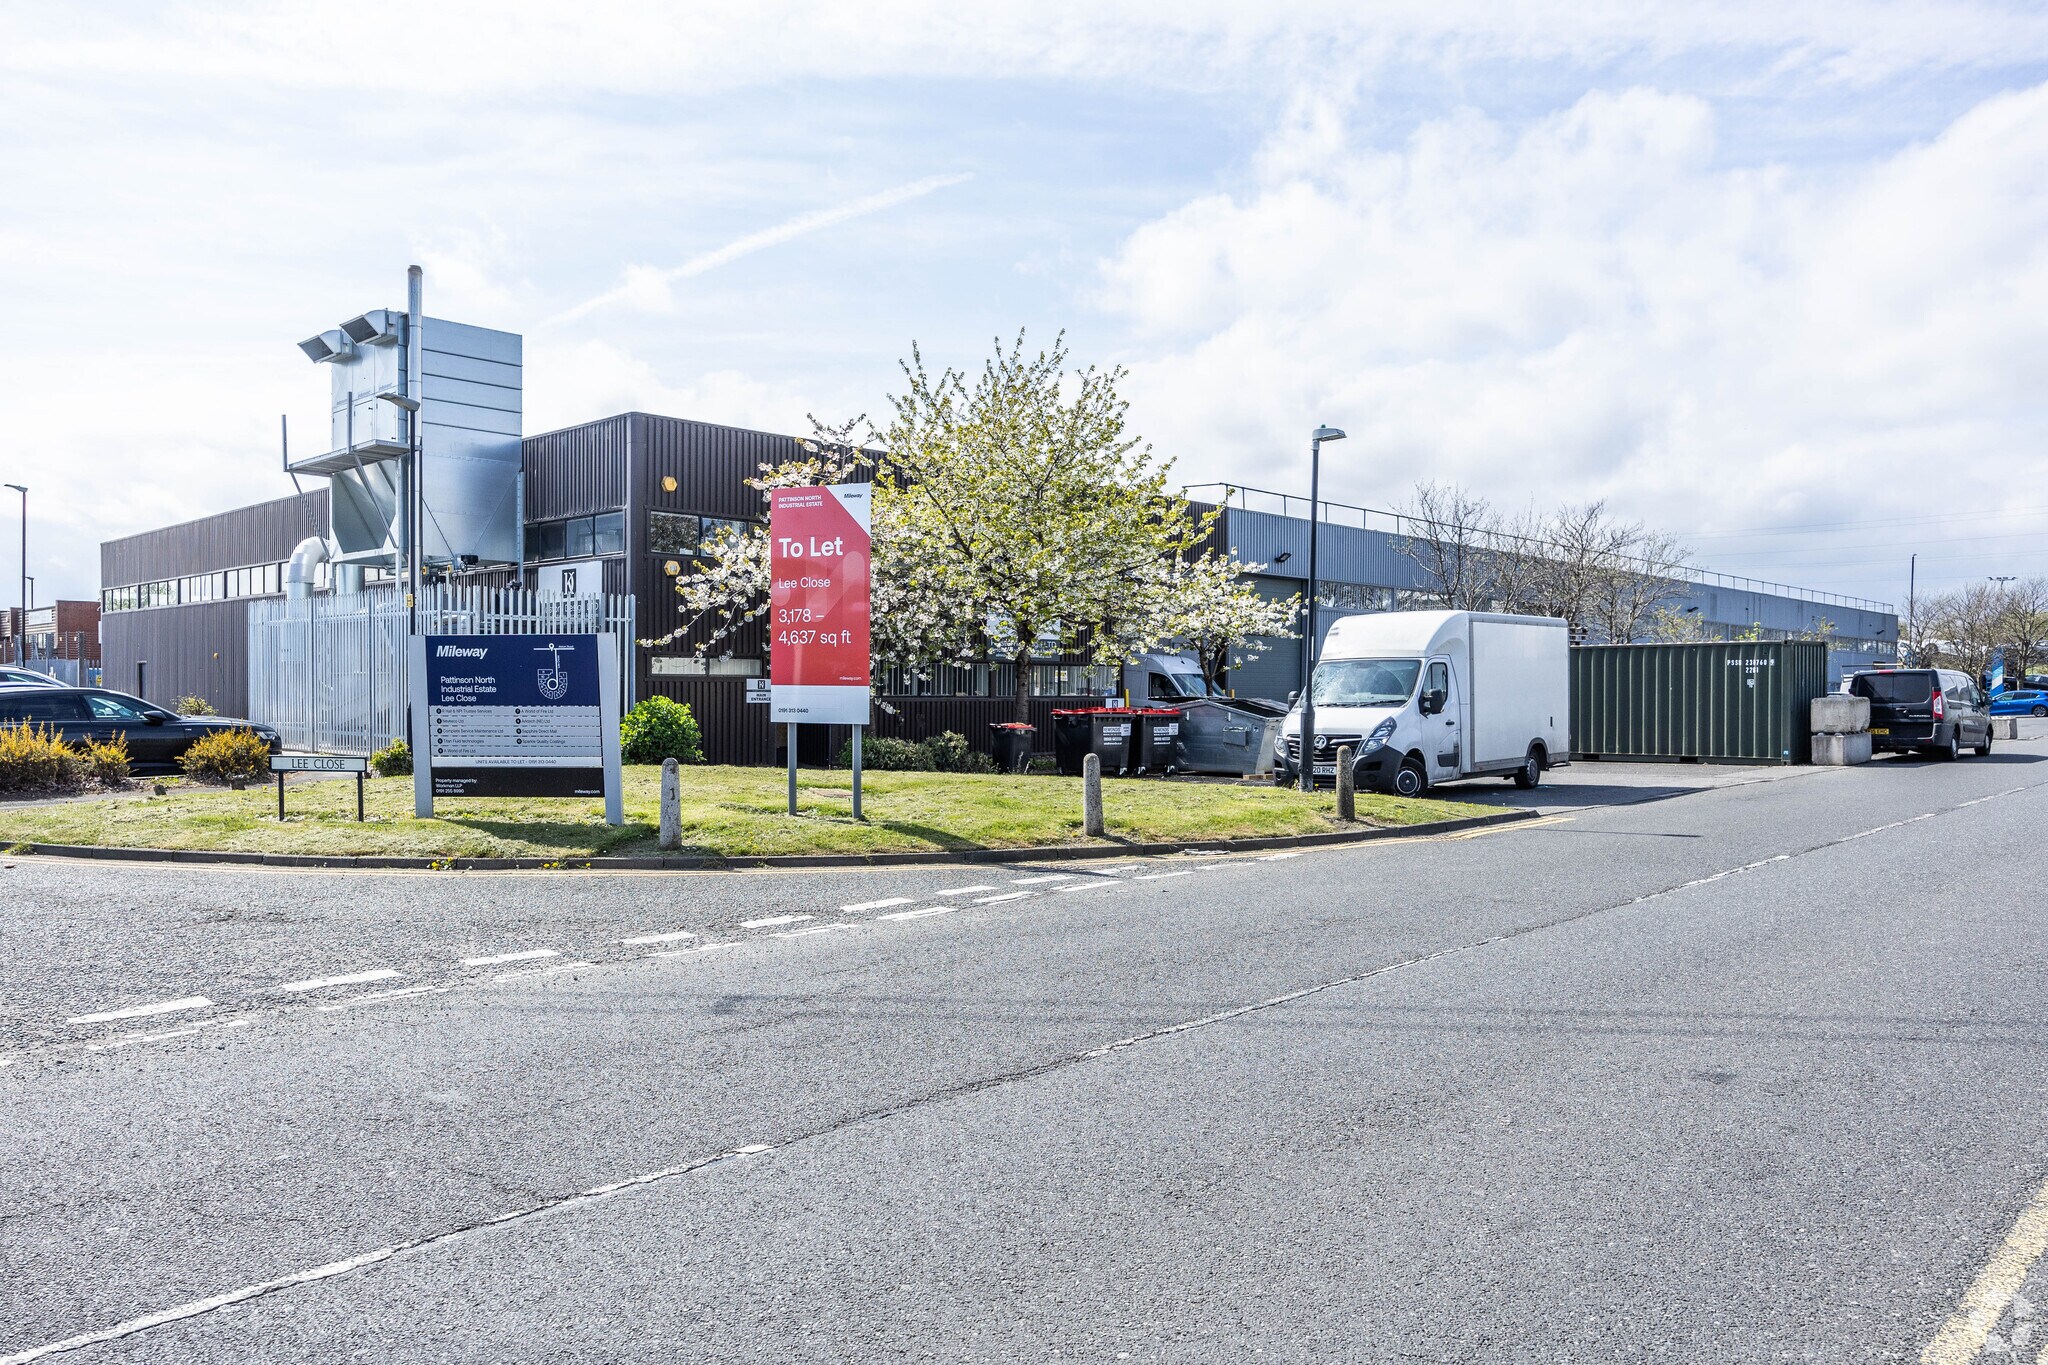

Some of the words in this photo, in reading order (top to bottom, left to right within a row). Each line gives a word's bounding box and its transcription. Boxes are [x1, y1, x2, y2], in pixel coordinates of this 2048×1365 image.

[778, 538, 803, 558] To
[810, 536, 843, 557] Let
[779, 578, 797, 588] Lee
[800, 577, 830, 588] Close
[779, 608, 811, 624] 3,178
[778, 630, 816, 646] 4,637
[820, 632, 837, 647] sq
[841, 630, 851, 644] ft
[436, 645, 488, 660] Mileway
[292, 759, 308, 768] LEE
[314, 759, 345, 769] CLOSE
